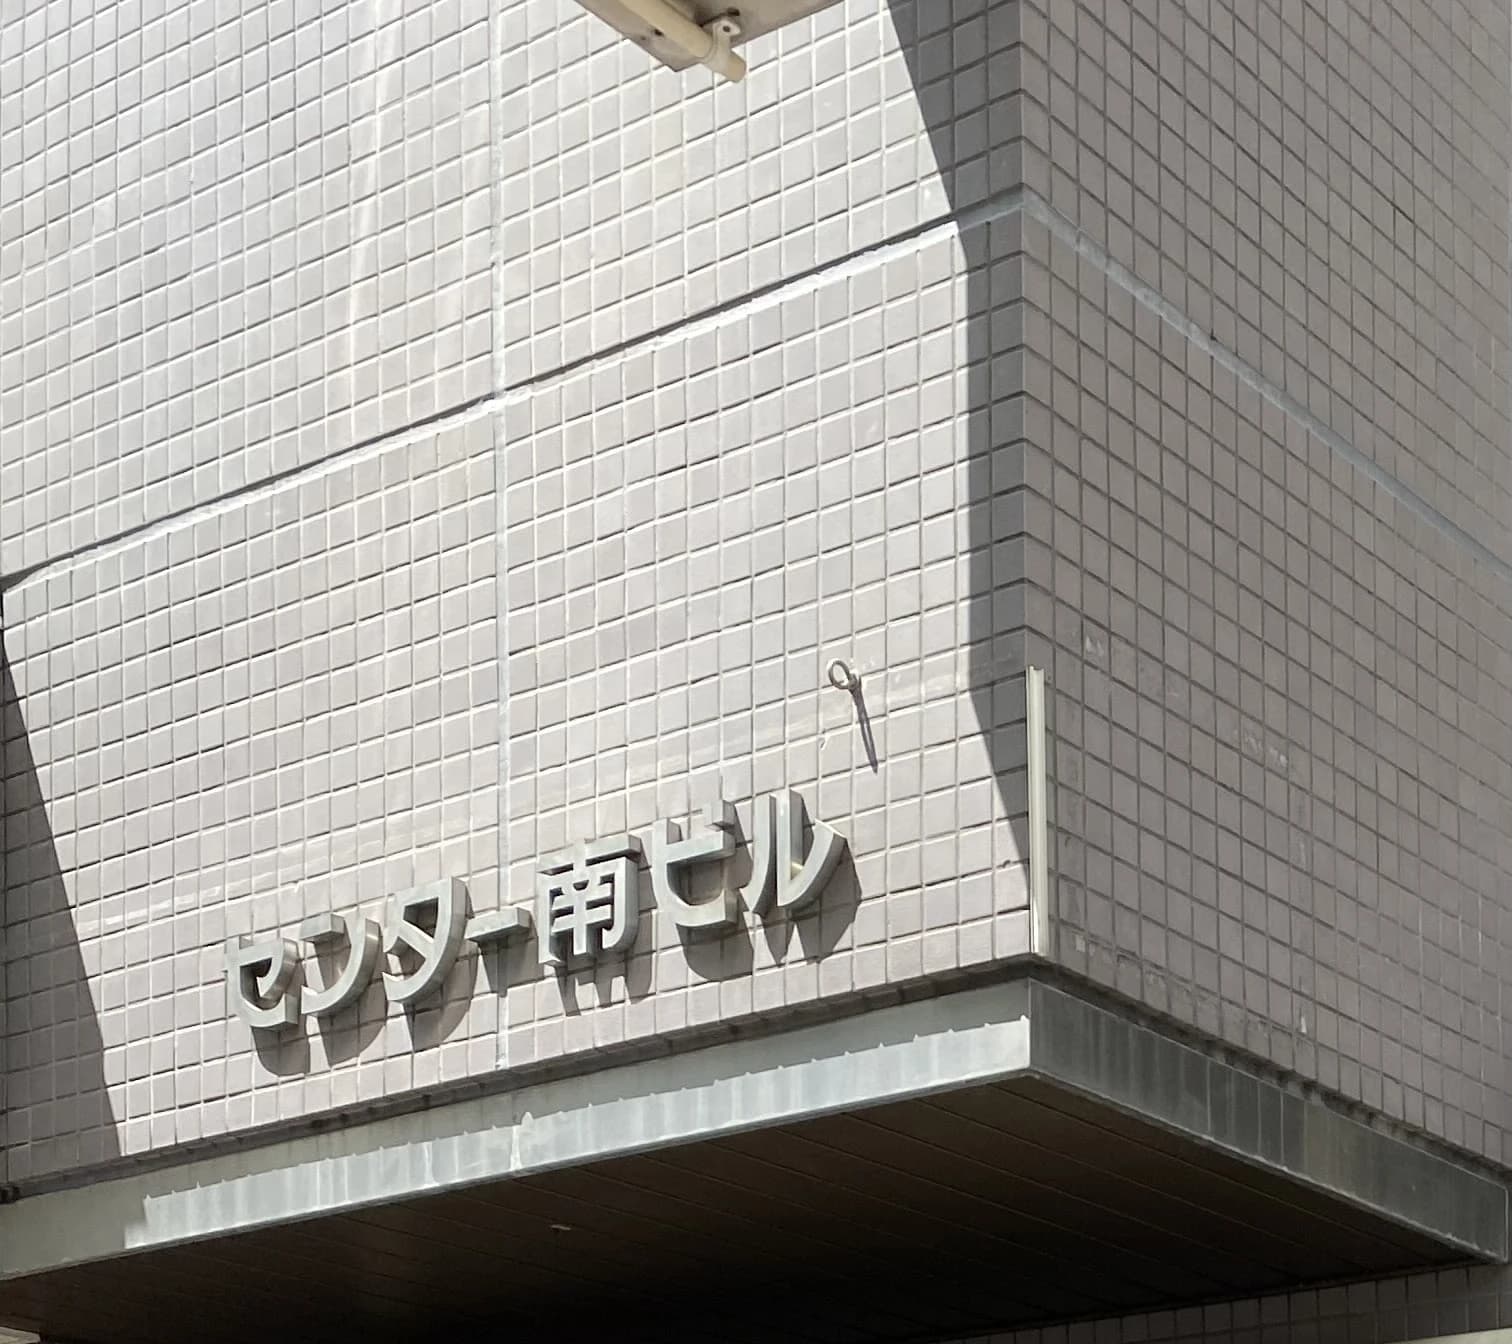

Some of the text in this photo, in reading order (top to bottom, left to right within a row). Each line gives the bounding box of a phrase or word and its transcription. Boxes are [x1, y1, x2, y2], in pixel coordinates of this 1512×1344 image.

[225, 788, 845, 1030] センター南ビル
